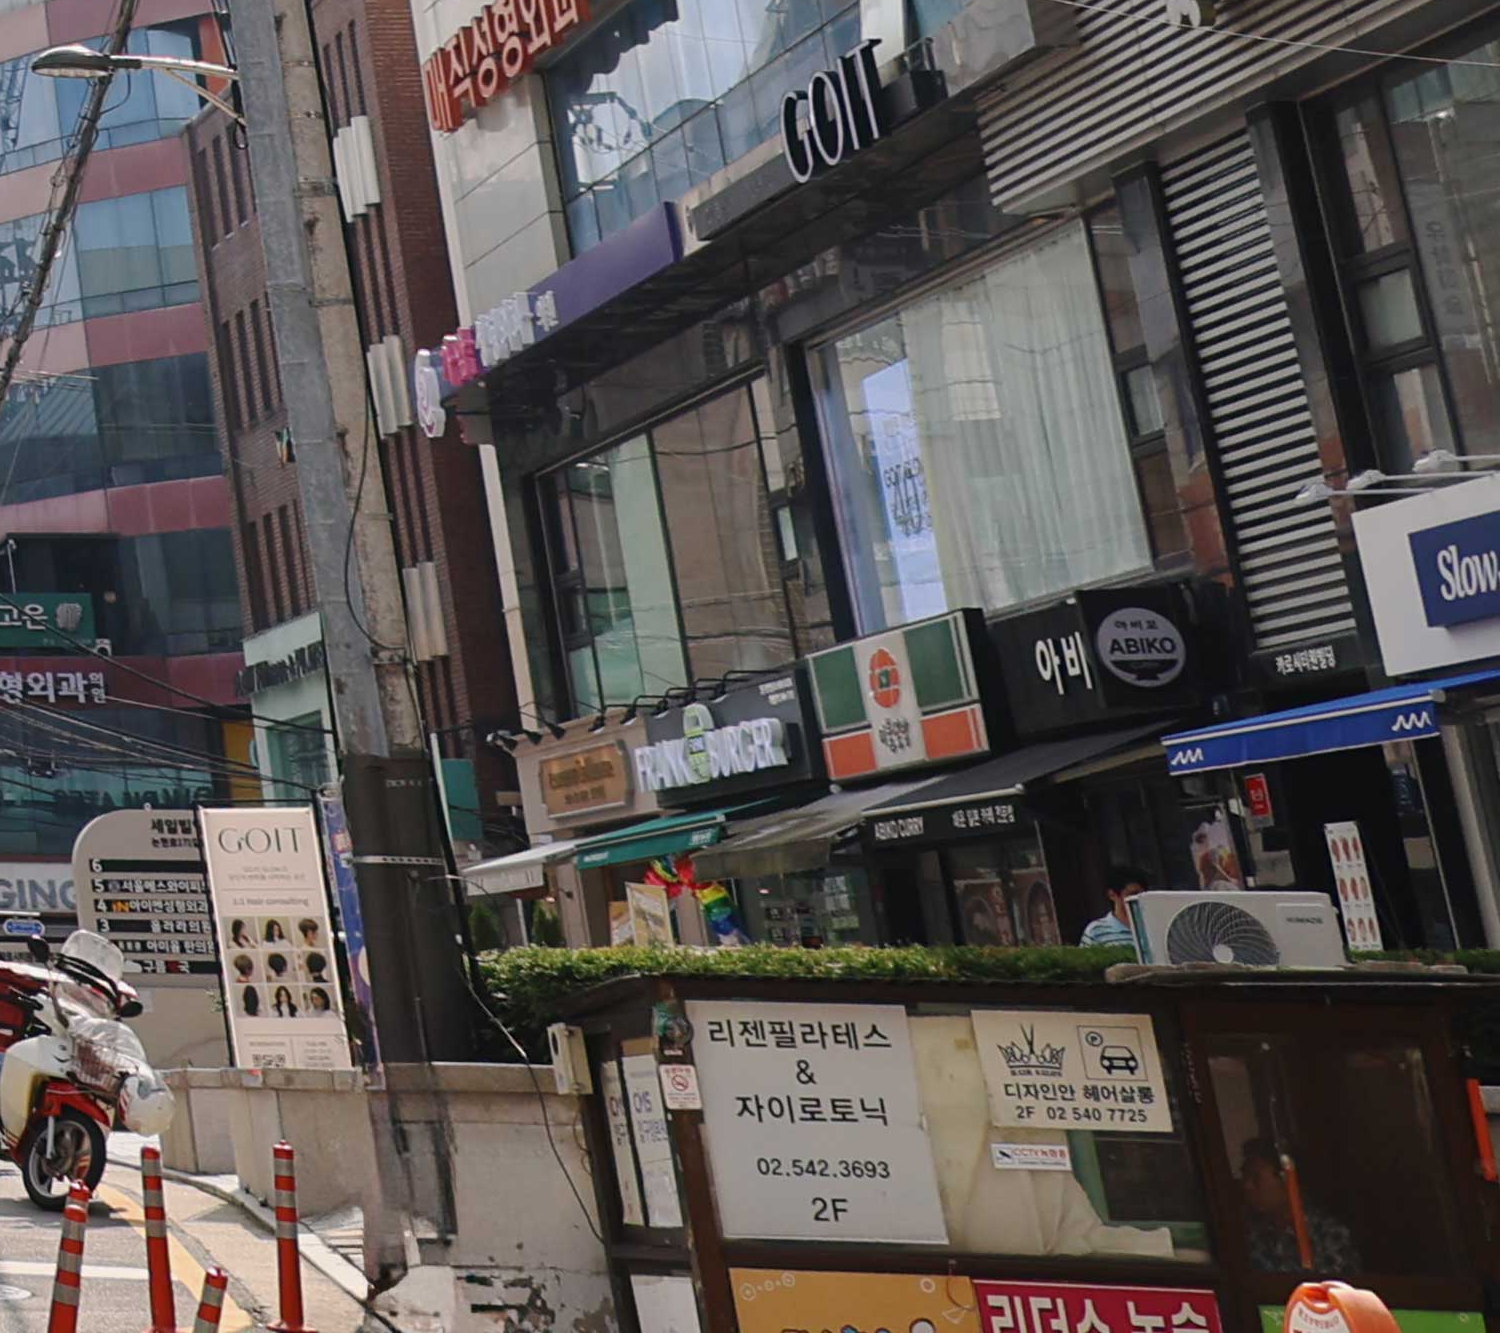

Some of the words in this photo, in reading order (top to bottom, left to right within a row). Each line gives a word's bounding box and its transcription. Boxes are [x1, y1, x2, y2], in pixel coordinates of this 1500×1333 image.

[781, 40, 881, 183] GOIT
[1109, 637, 1177, 656] ABIKO
[218, 827, 303, 856] GOIT
[92, 859, 102, 872] 6
[95, 880, 104, 893] 5
[97, 900, 106, 912] 4
[100, 919, 110, 932] 3
[707, 1019, 892, 1050] 리젠필라테스
[796, 1060, 817, 1085] &
[1004, 1082, 1076, 1102] 디자인안
[1083, 1083, 1154, 1105] 헤어살롱
[736, 1094, 888, 1126] 자이로토닉
[1015, 1106, 1035, 1120] 2F
[1047, 1106, 1068, 1121] 02
[1072, 1107, 1102, 1122] 540
[1108, 1107, 1148, 1123] 7725
[757, 1157, 890, 1180] 02.542.3693
[811, 1197, 850, 1223] 2F
